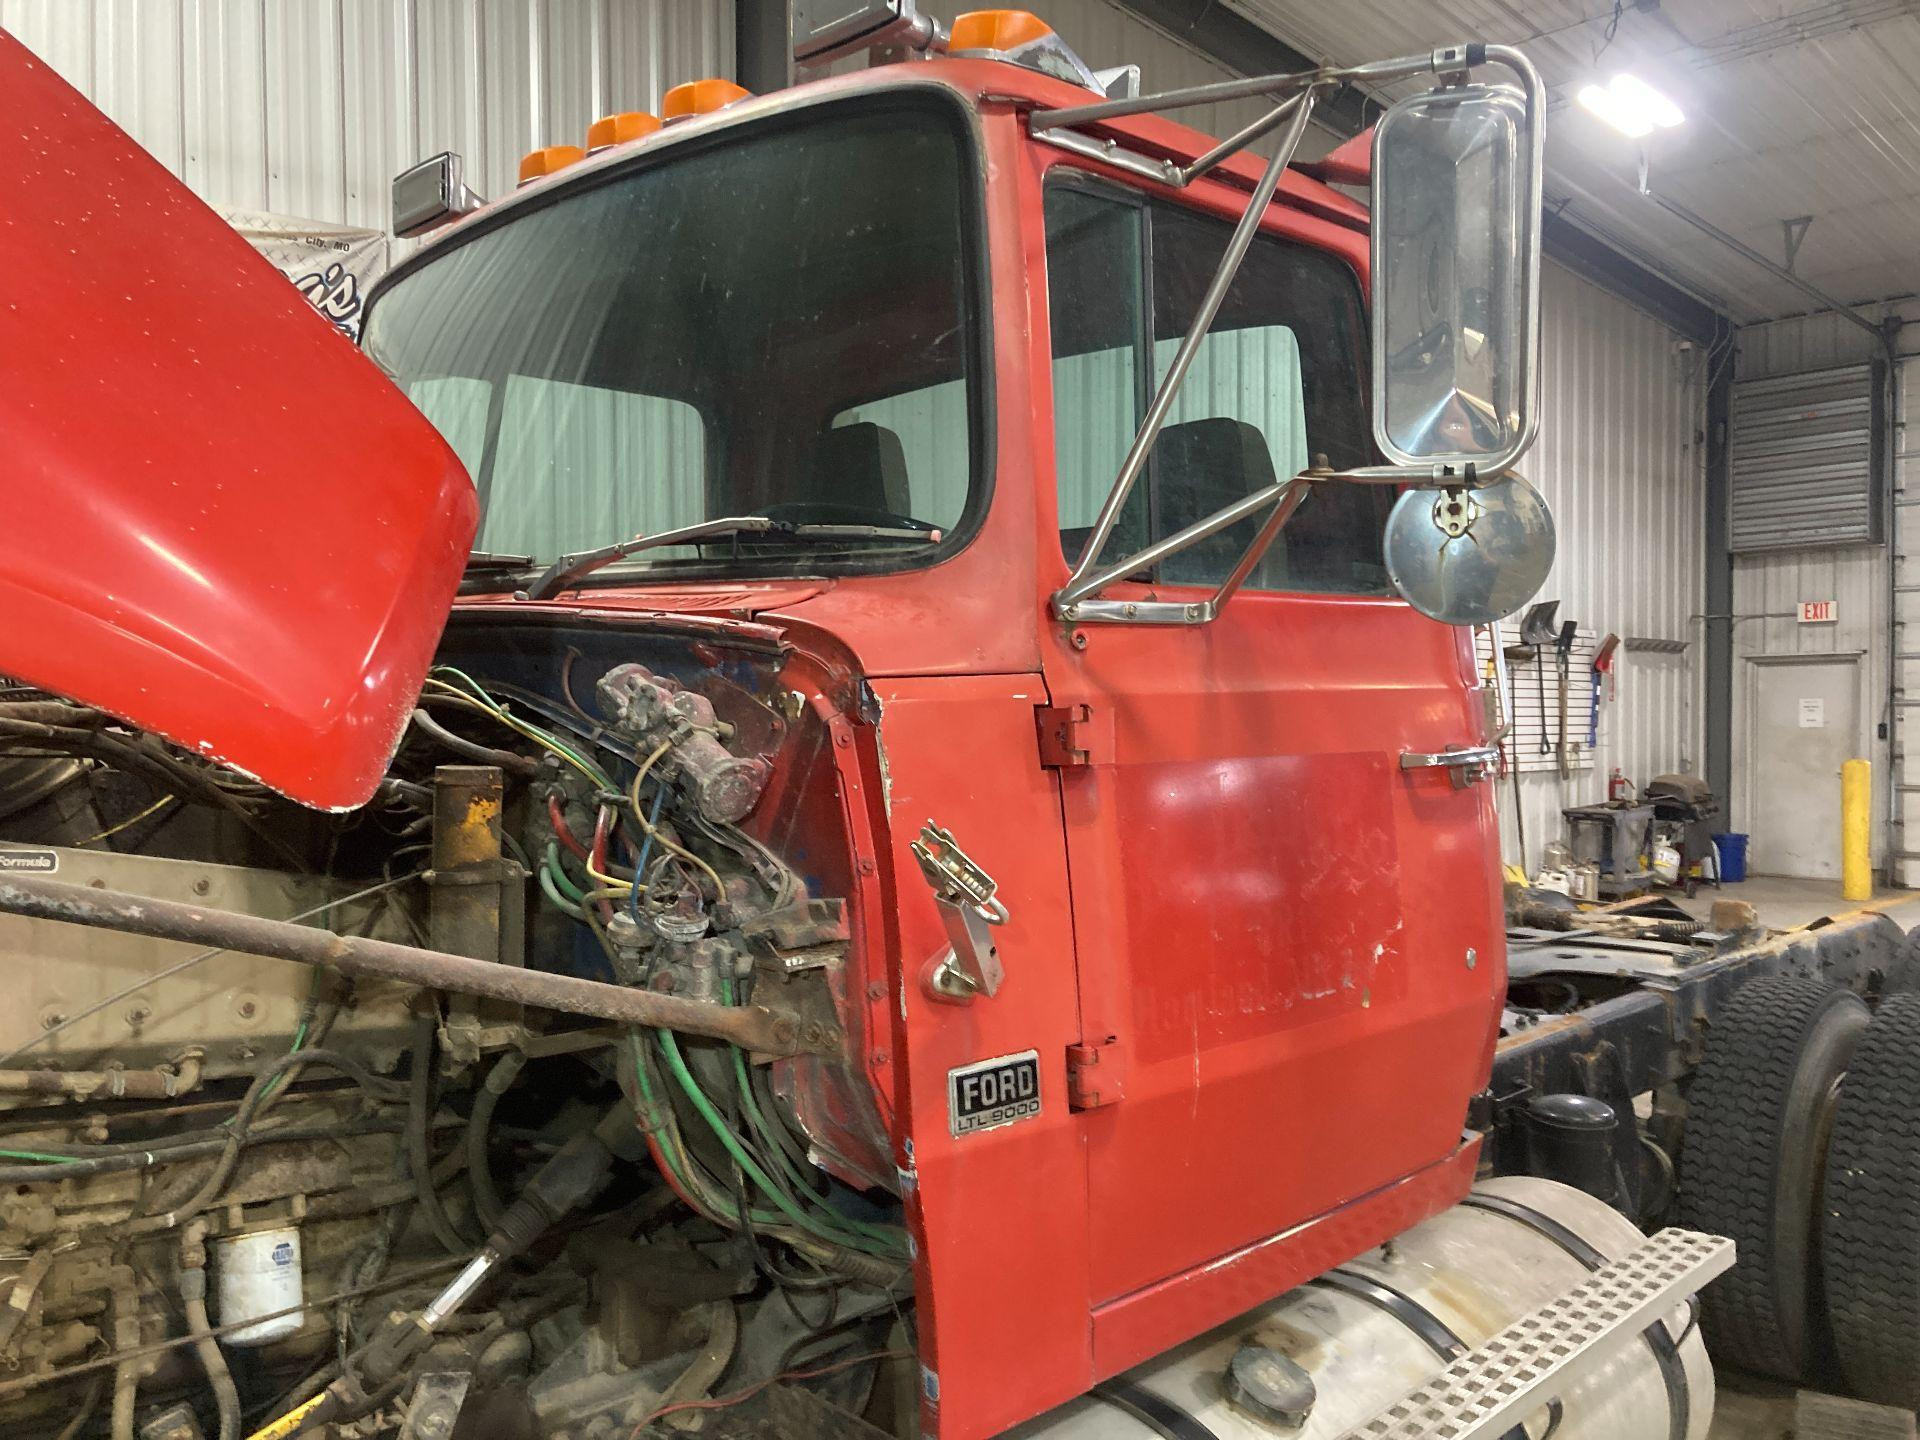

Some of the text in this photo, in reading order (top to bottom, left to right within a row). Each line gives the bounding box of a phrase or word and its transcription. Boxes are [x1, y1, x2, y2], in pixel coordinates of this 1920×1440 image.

[333, 241, 350, 252] MO
[1804, 602, 1830, 620] EXIT
[962, 1065, 1034, 1111] FORD
[958, 1100, 1040, 1131] LTL 9000
